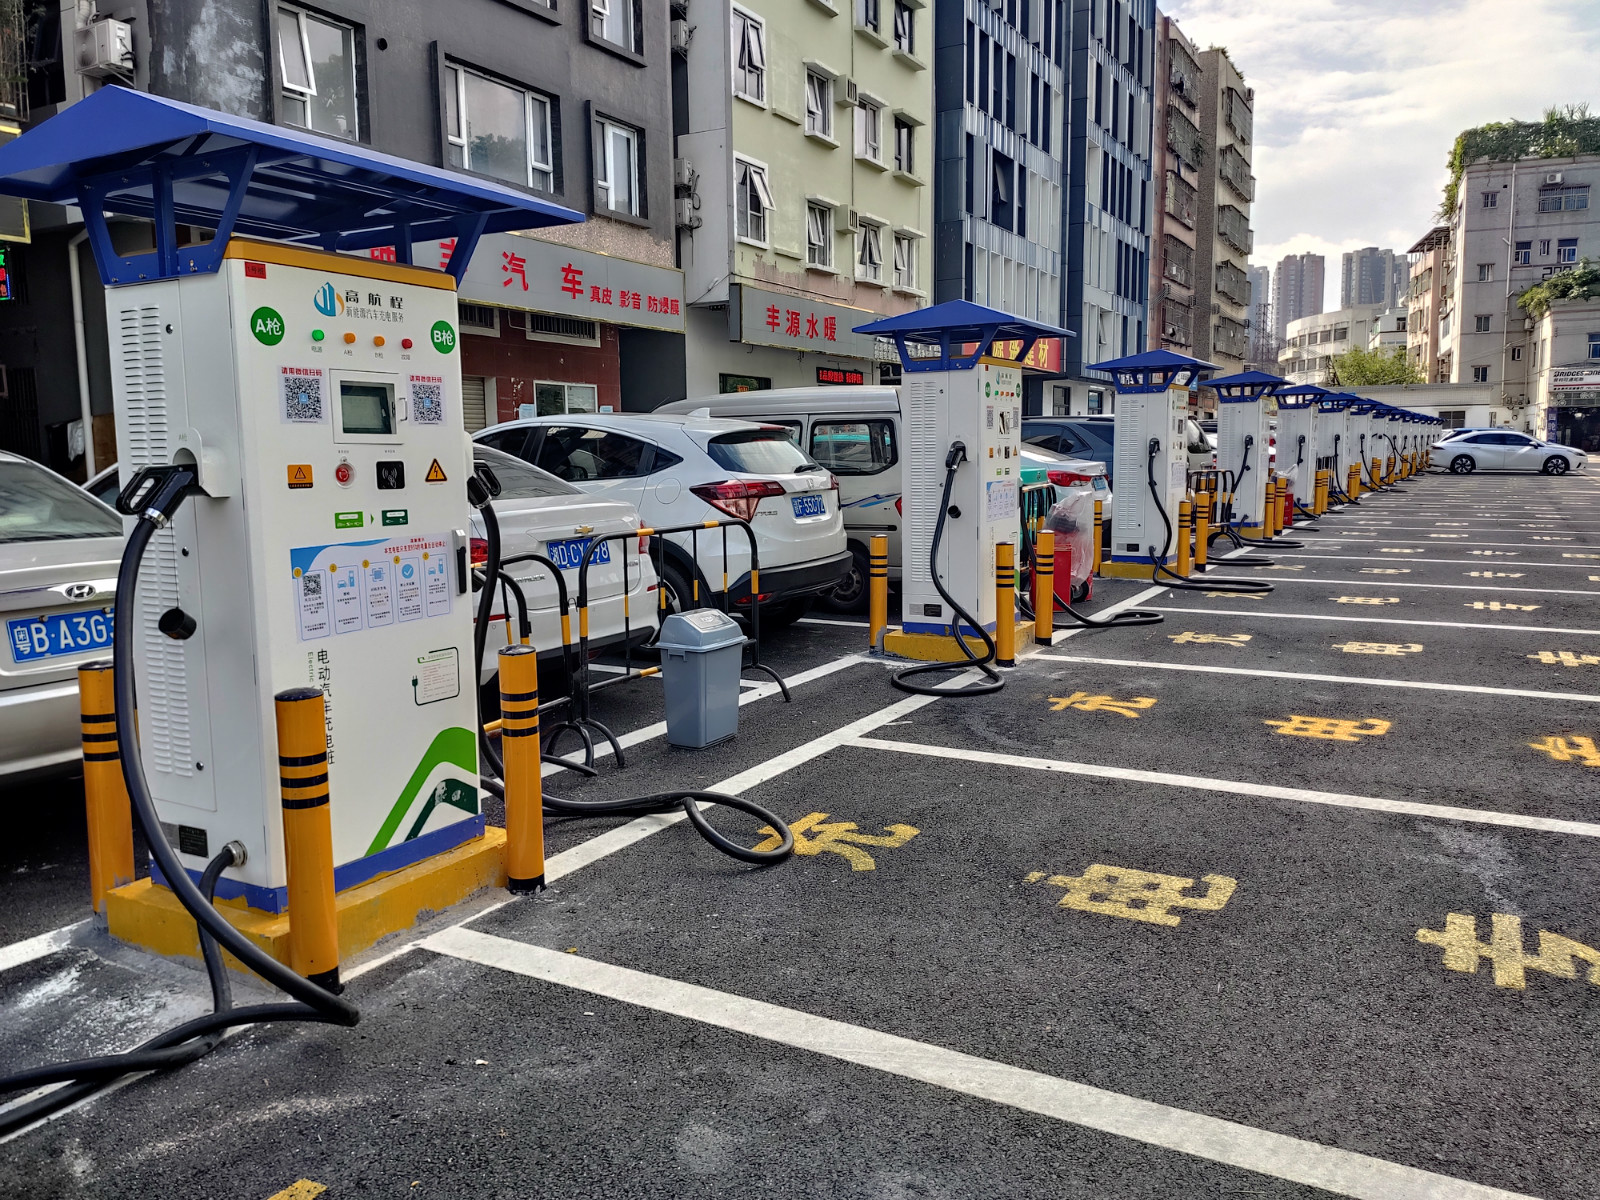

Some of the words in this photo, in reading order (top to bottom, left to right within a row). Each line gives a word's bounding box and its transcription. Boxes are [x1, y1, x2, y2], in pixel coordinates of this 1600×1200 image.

[345, 289, 404, 310] 高航程
[590, 285, 613, 305] 真皮
[619, 290, 641, 310] 影音
[647, 295, 680, 316] 防爆膜
[346, 306, 404, 323] 新能源汽车充电服务
[765, 304, 837, 342] 丰源水暖
[255, 317, 282, 336] A枪
[433, 330, 454, 346] B枪
[281, 366, 323, 376] 请用微信扫码
